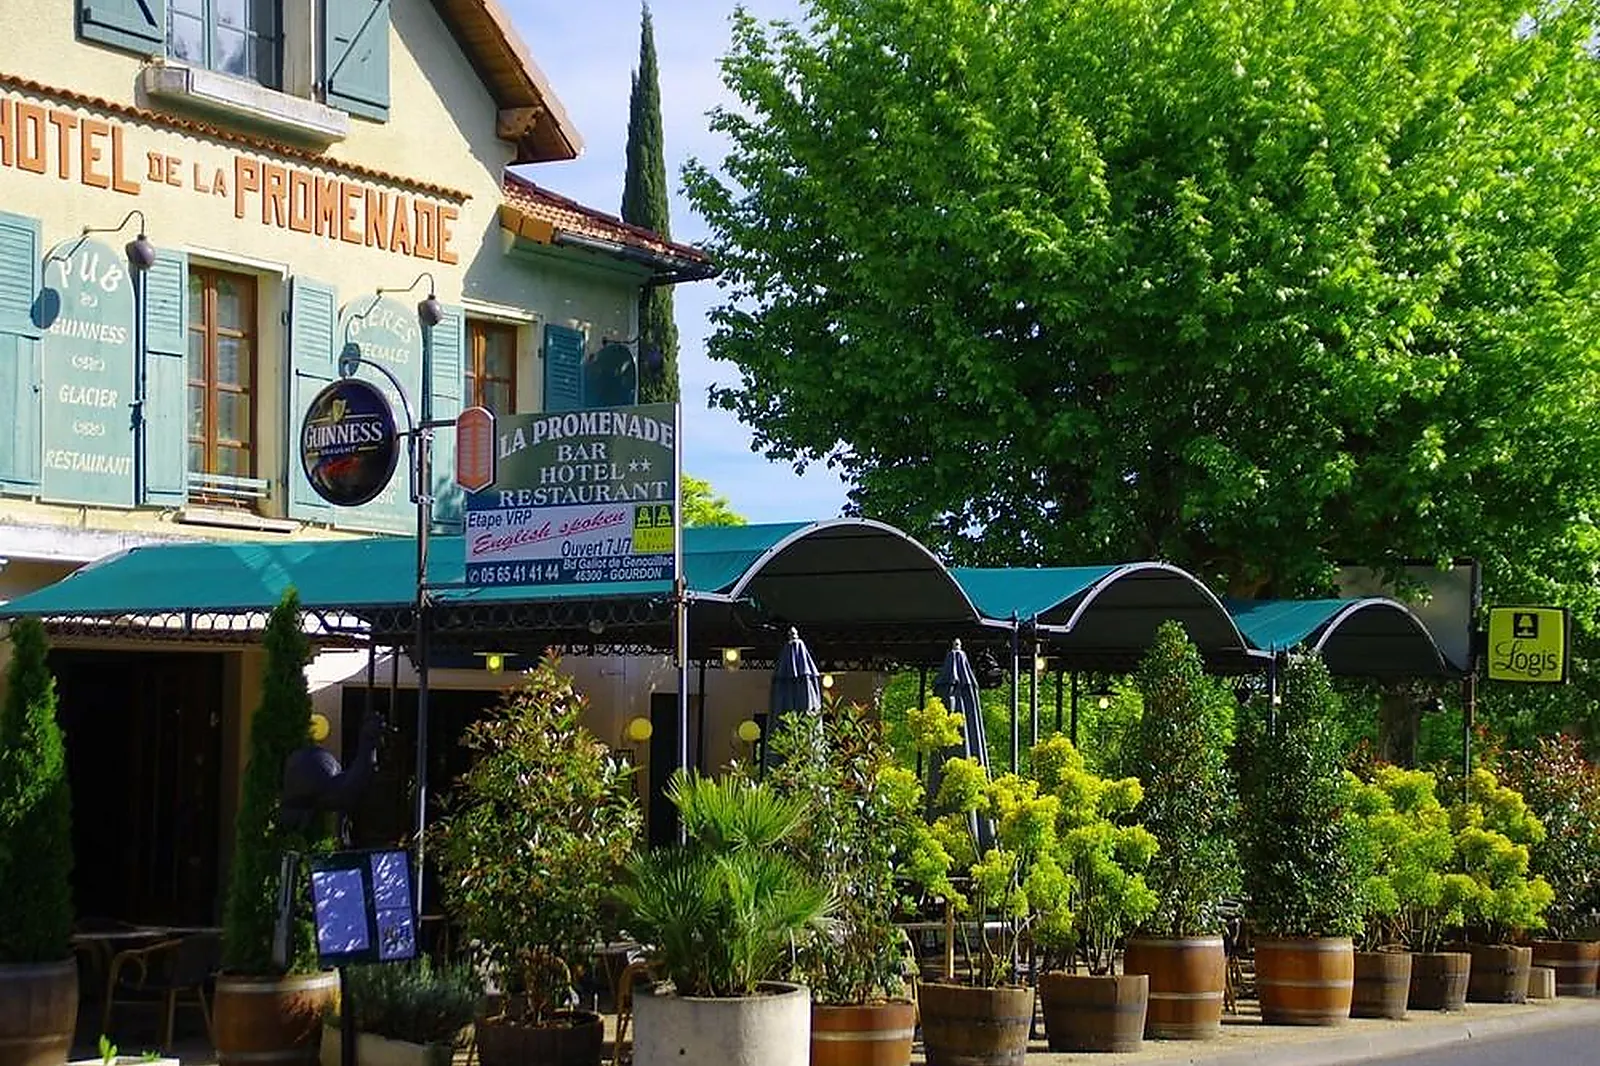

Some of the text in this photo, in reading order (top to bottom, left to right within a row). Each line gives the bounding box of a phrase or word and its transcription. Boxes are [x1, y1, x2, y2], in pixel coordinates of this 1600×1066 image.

[147, 151, 182, 188] DE
[193, 162, 228, 198] LA
[234, 155, 459, 266] PROMENADE
[59, 251, 123, 292] PUB
[49, 317, 127, 344] GUINNESS
[59, 384, 118, 409] GLACIER
[304, 421, 383, 449] GUINNESS
[500, 412, 674, 459] LA PROMENADE
[44, 450, 132, 476] RESTAURANT
[557, 442, 607, 462] BAR
[540, 463, 625, 484] HOTEL
[499, 481, 668, 507] RESTAURANT
[506, 509, 532, 525] VRP
[561, 540, 602, 557] Ouvert
[481, 563, 560, 582] 05 65 41 41 44
[610, 567, 663, 581] GOURDON
[1492, 640, 1558, 677] Logis
